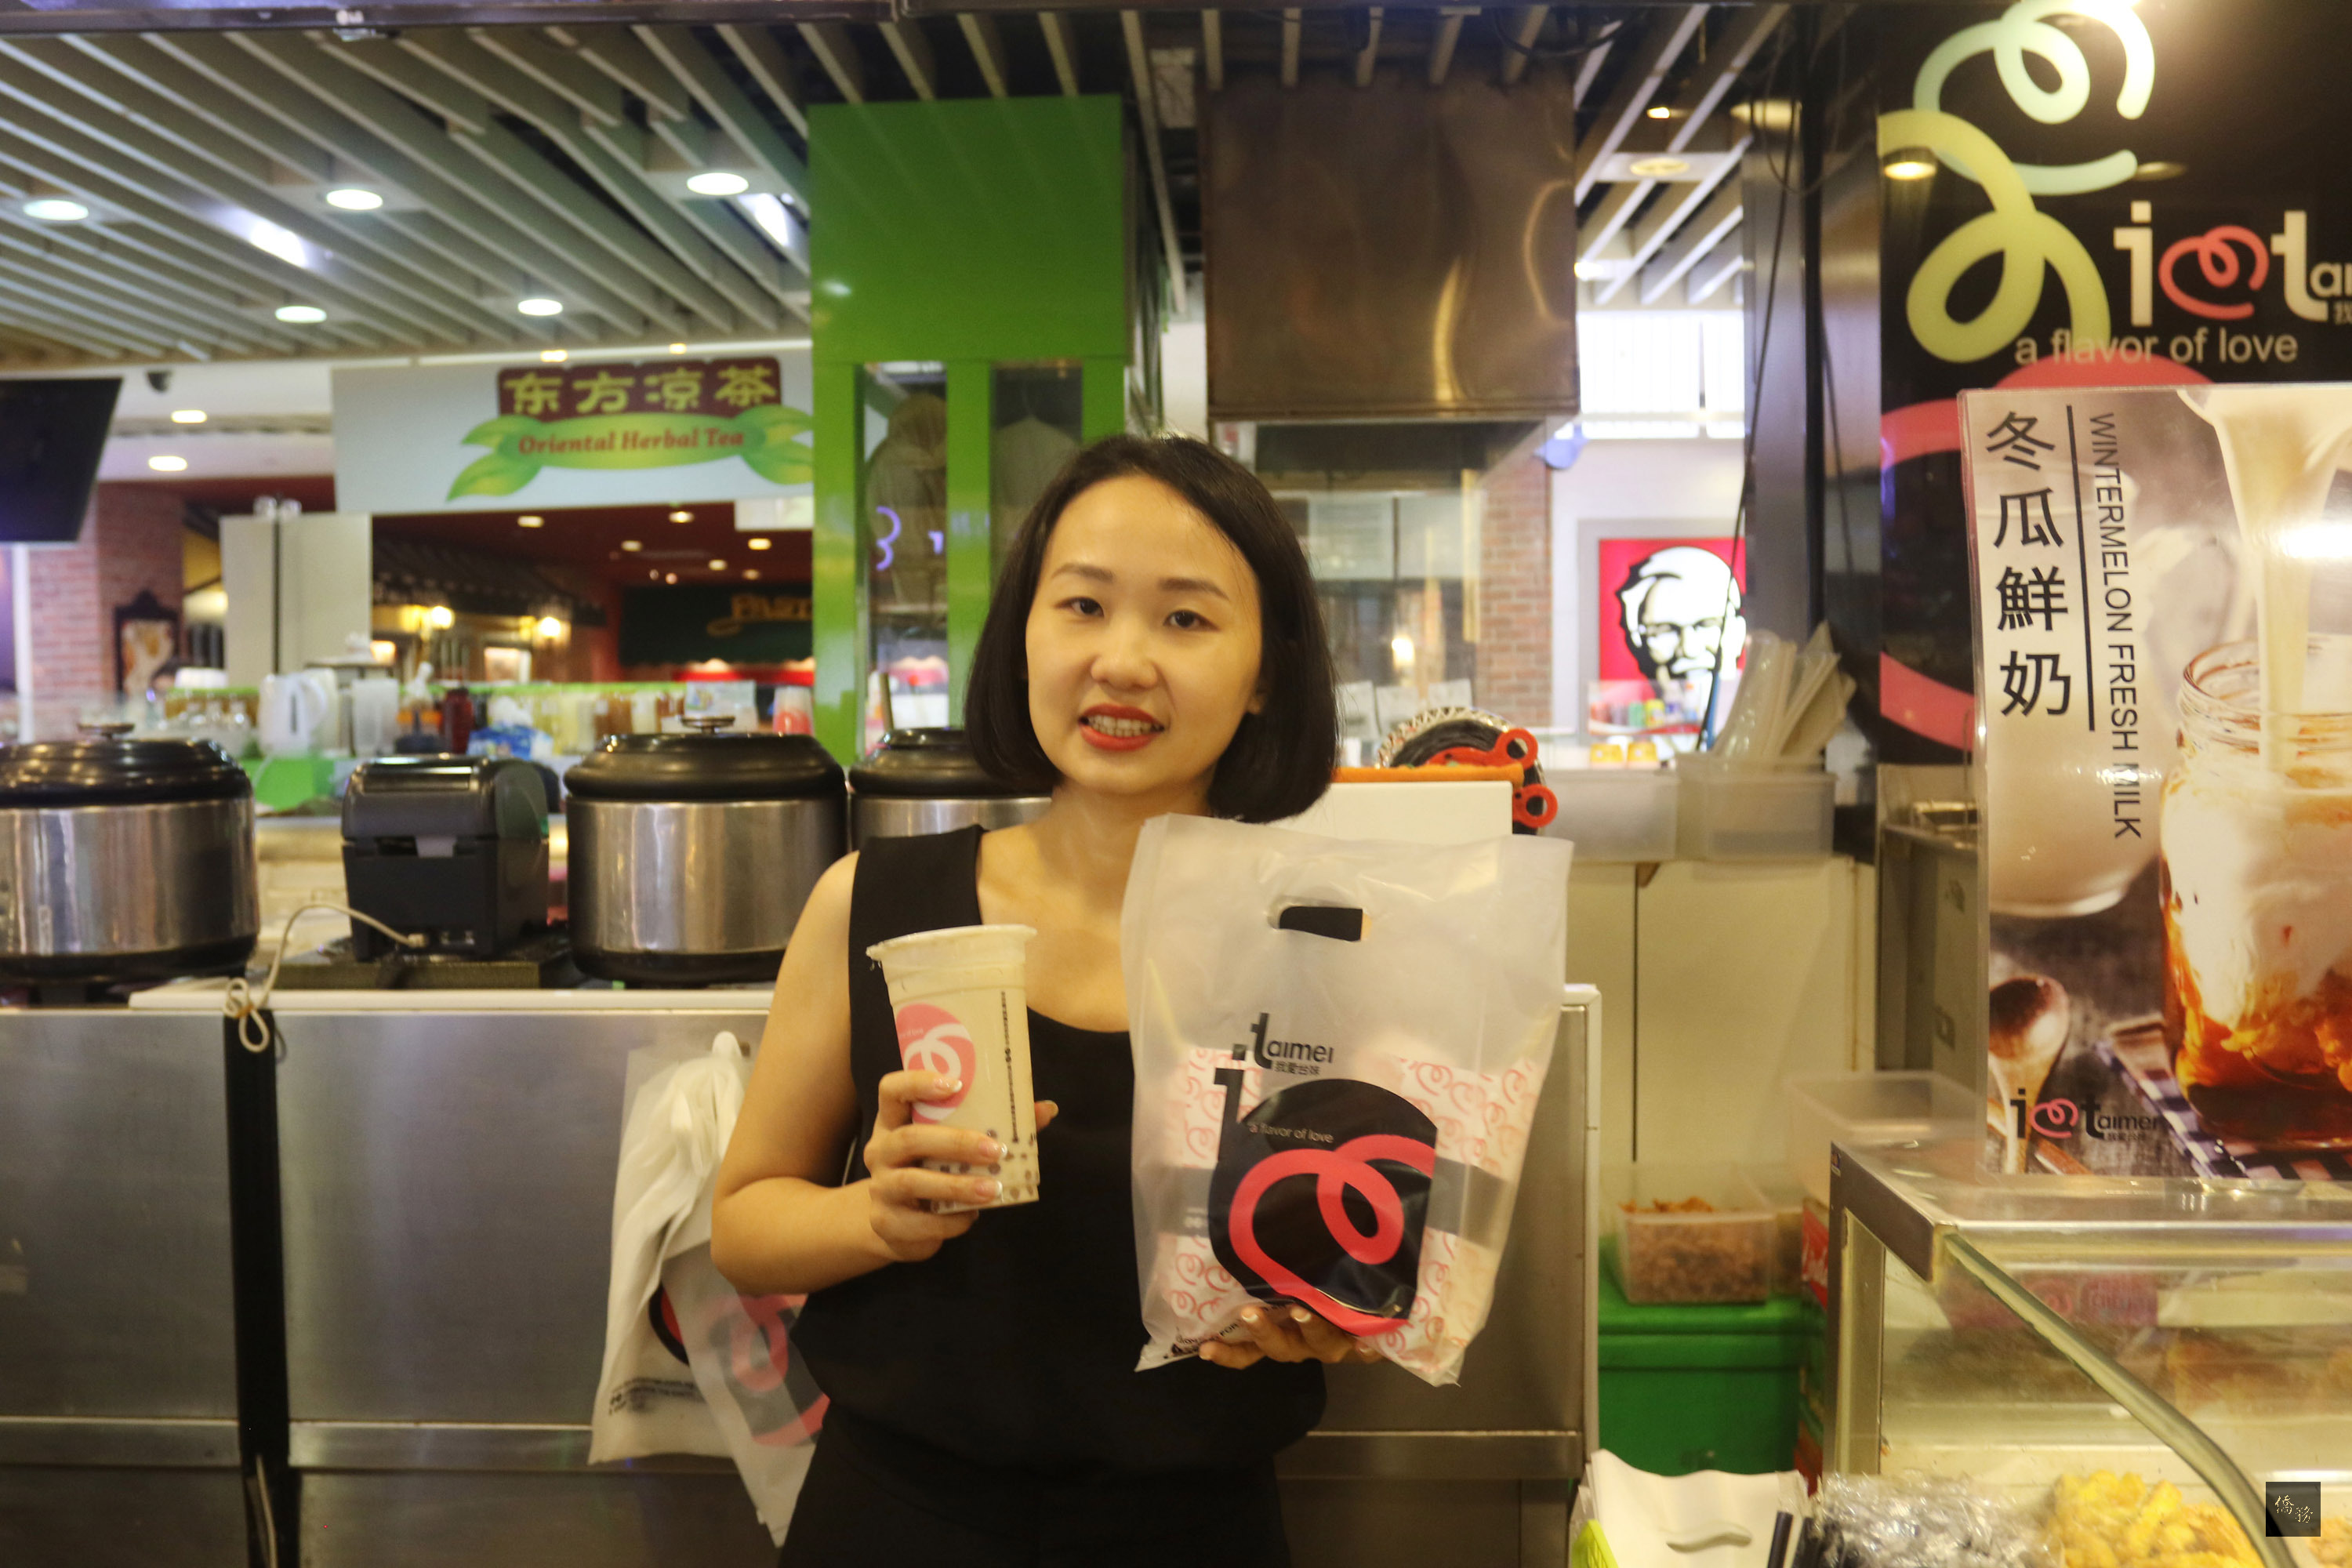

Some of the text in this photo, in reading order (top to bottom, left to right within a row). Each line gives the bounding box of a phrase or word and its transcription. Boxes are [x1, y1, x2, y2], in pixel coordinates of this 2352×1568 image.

[2015, 326, 2299, 365] a flavor of love
[518, 427, 743, 455] Oriental Herbal Tea
[1985, 412, 2072, 717] 冬瓜鮮奶
[2089, 412, 2142, 839] WINTERMELON FRESH MILK
[1294, 1127, 1308, 1140] of
[1308, 1129, 1334, 1144] love
